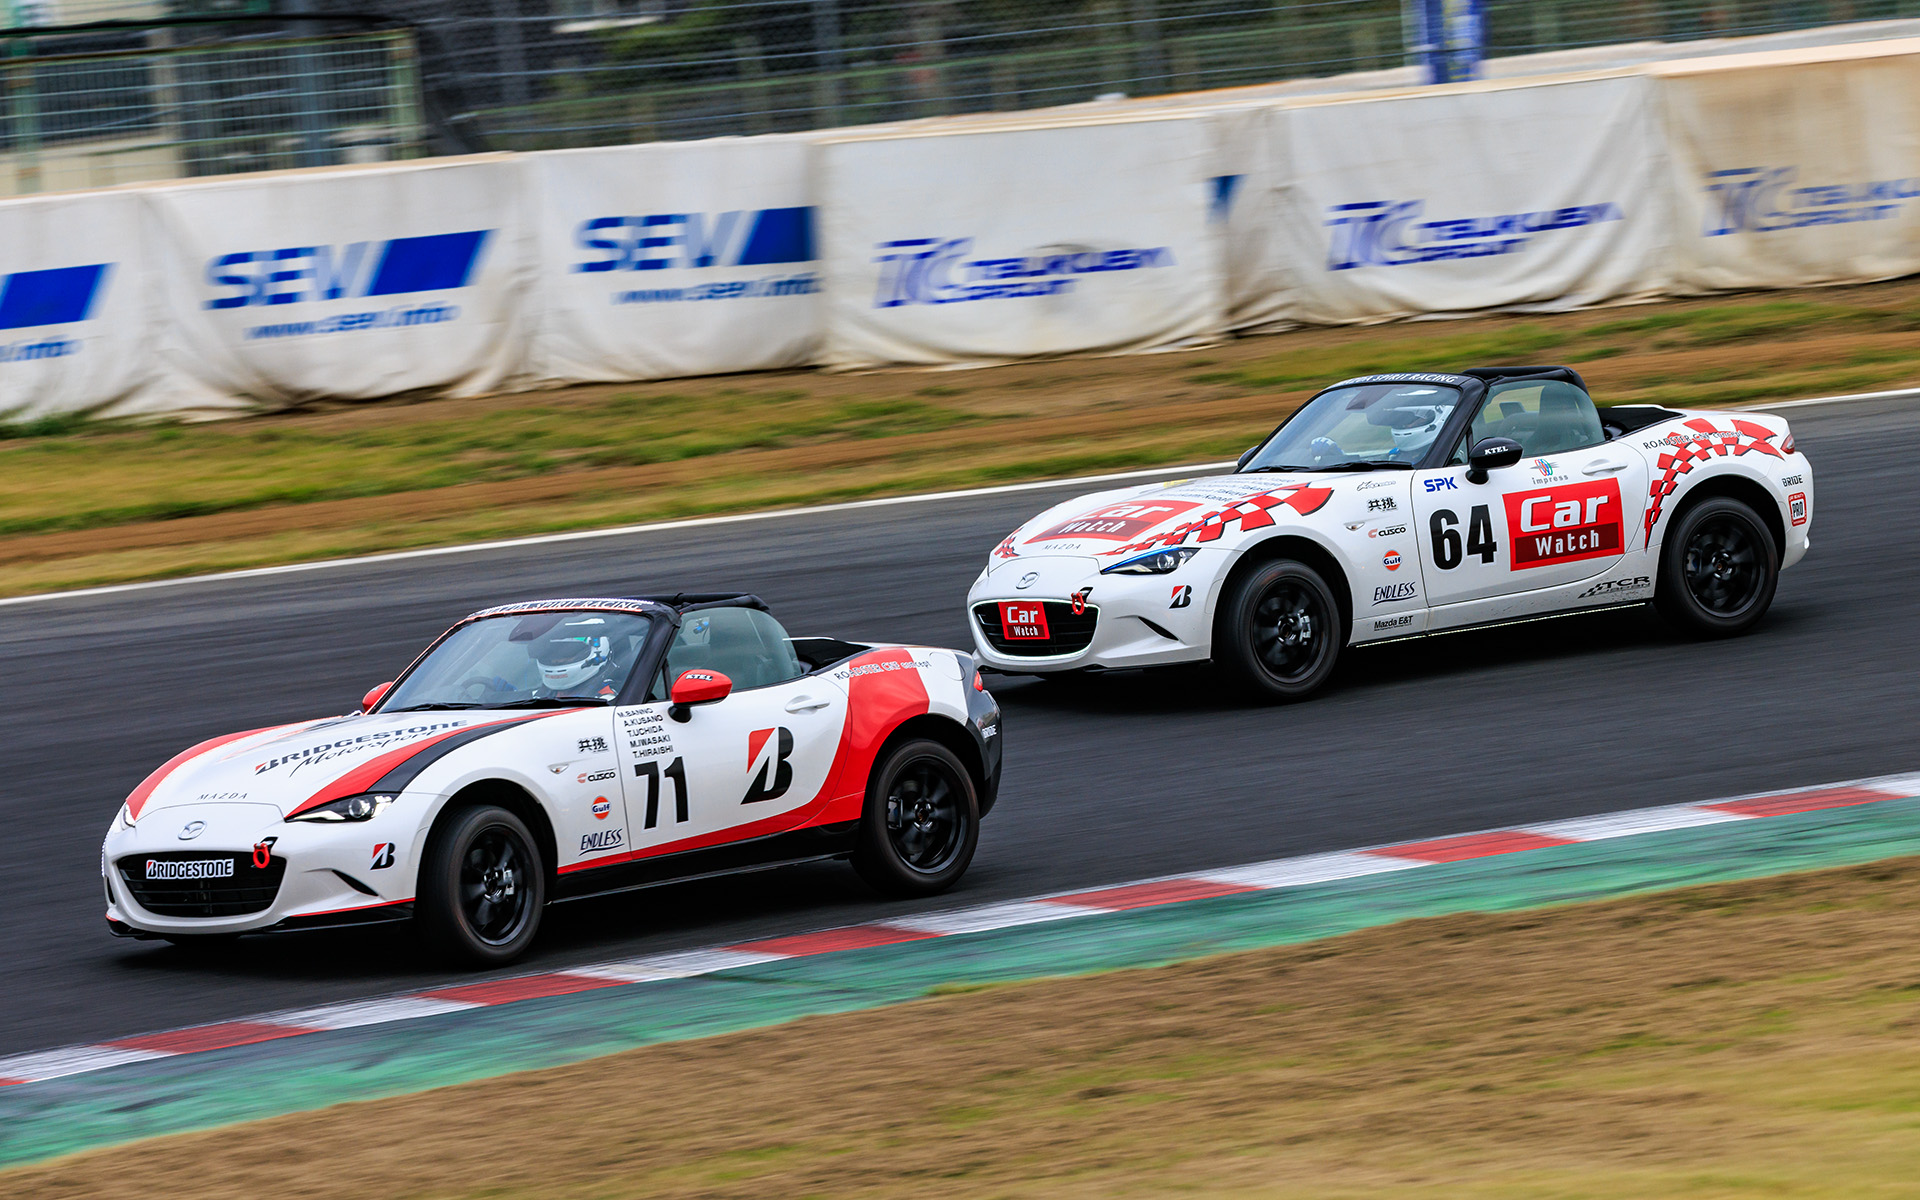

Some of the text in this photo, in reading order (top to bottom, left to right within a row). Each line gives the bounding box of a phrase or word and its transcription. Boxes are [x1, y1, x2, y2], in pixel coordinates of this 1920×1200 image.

[202, 243, 374, 309] SEV
[1412, 372, 1458, 382] RACING
[1643, 434, 1692, 450] ROADSTER
[1484, 445, 1508, 455] KTEL
[1423, 476, 1458, 492] SPK
[1532, 474, 1569, 486] impress
[1782, 474, 1803, 488] BRIDE
[1520, 495, 1609, 533] Car
[1058, 520, 1127, 535] Watch
[1378, 526, 1407, 537] CUSCO
[1429, 504, 1497, 570] 64
[1535, 529, 1600, 557] Watch
[1043, 543, 1081, 551] MAZDA
[1383, 556, 1401, 566] Gulf
[1602, 576, 1650, 589] TCR
[1373, 581, 1416, 602] ENDLESS
[580, 599, 641, 610] RACING
[1007, 606, 1039, 623] Car
[1374, 618, 1398, 630] Mazda
[1398, 615, 1413, 626] E&T
[1013, 625, 1039, 637] Watch
[685, 673, 714, 682] KTEL
[834, 662, 885, 680] ROADSTER
[623, 714, 664, 727] A.KUSANO
[627, 725, 664, 738] T.UCHIDA
[255, 719, 468, 776] BRIDGESTONE
[629, 734, 671, 749] M.IWASAKI
[289, 730, 436, 778] Motorsport
[632, 745, 674, 759] T.HIRAISHI
[587, 770, 616, 783] CUSCO
[198, 792, 248, 800] MAZDA
[634, 756, 689, 830] 71
[592, 803, 610, 813] Gulf
[580, 828, 623, 851] ENDLESS
[147, 859, 233, 879] BRIDGESTONE
